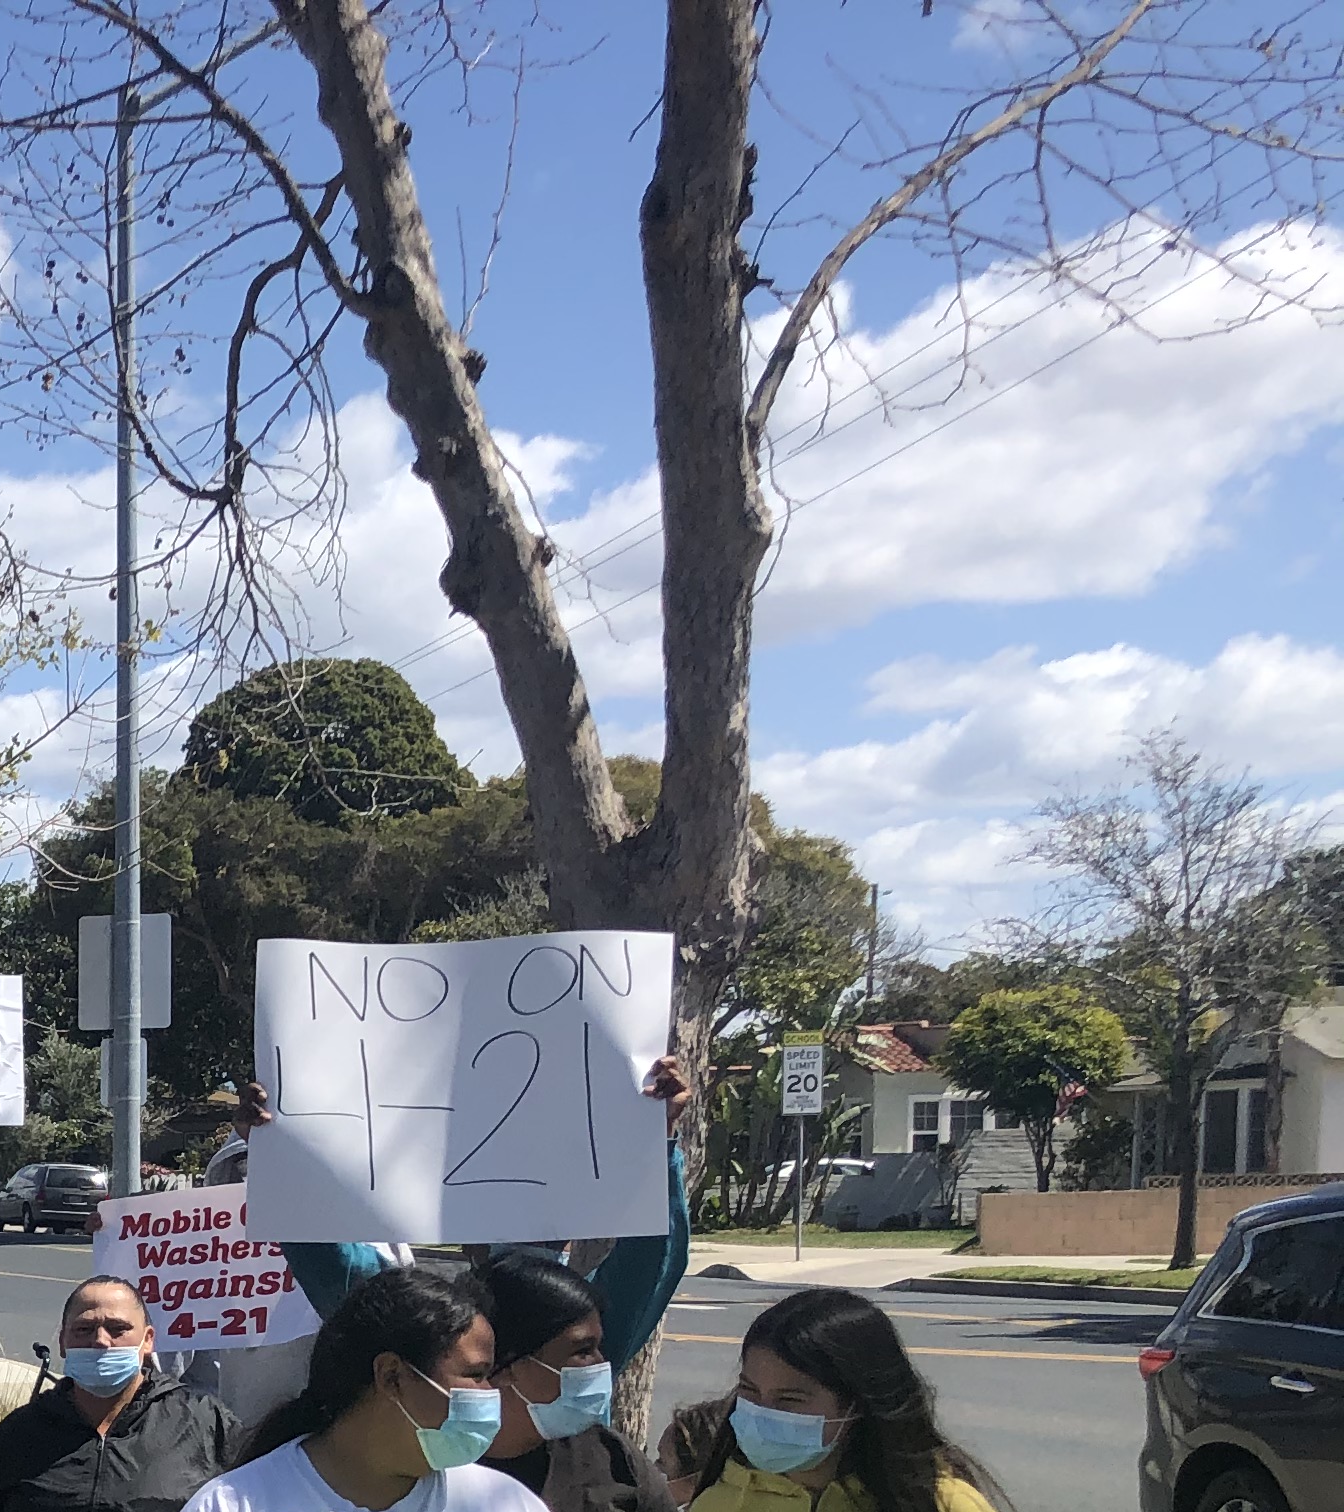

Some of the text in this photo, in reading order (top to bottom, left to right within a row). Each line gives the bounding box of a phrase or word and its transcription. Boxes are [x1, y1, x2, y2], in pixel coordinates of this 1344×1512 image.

[310, 939, 632, 1022] NO ON
[785, 1034, 820, 1044] SCHOOL
[786, 1050, 820, 1060] SPEED
[789, 1061, 817, 1071] LIMIT
[786, 1073, 819, 1094] 20
[275, 1021, 600, 1192] 4-21
[118, 1206, 232, 1241] Mobile
[136, 1235, 284, 1269] Washers
[138, 1269, 297, 1312] Against
[167, 1306, 268, 1339] 4-21
